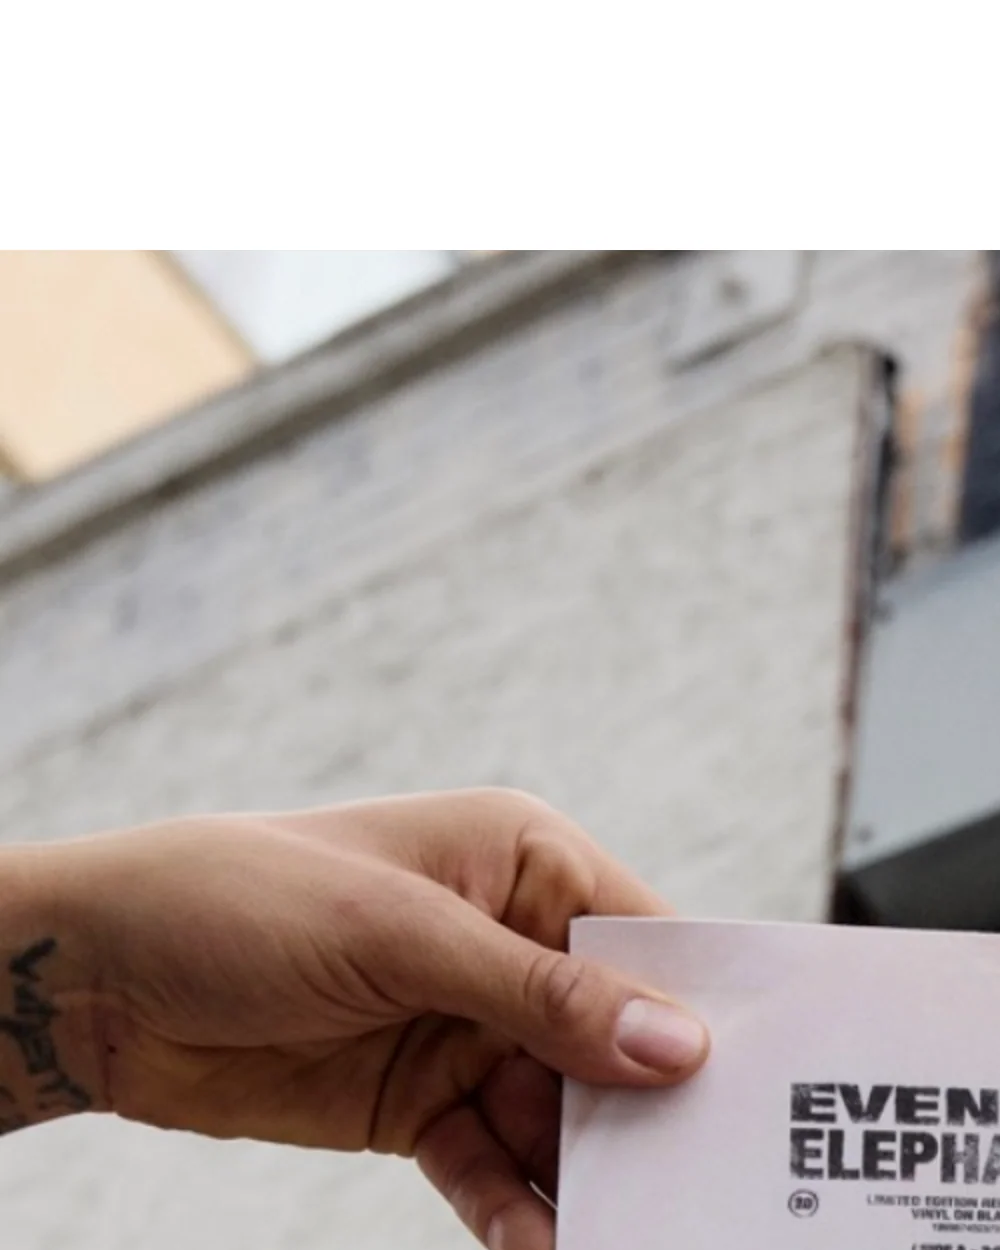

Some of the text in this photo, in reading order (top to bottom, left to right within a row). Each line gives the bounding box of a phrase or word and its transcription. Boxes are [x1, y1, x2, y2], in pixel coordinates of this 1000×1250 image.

[925, 1195, 977, 1208] EDITION
[912, 1208, 950, 1221] VINYL
[954, 1208, 973, 1221] ON
